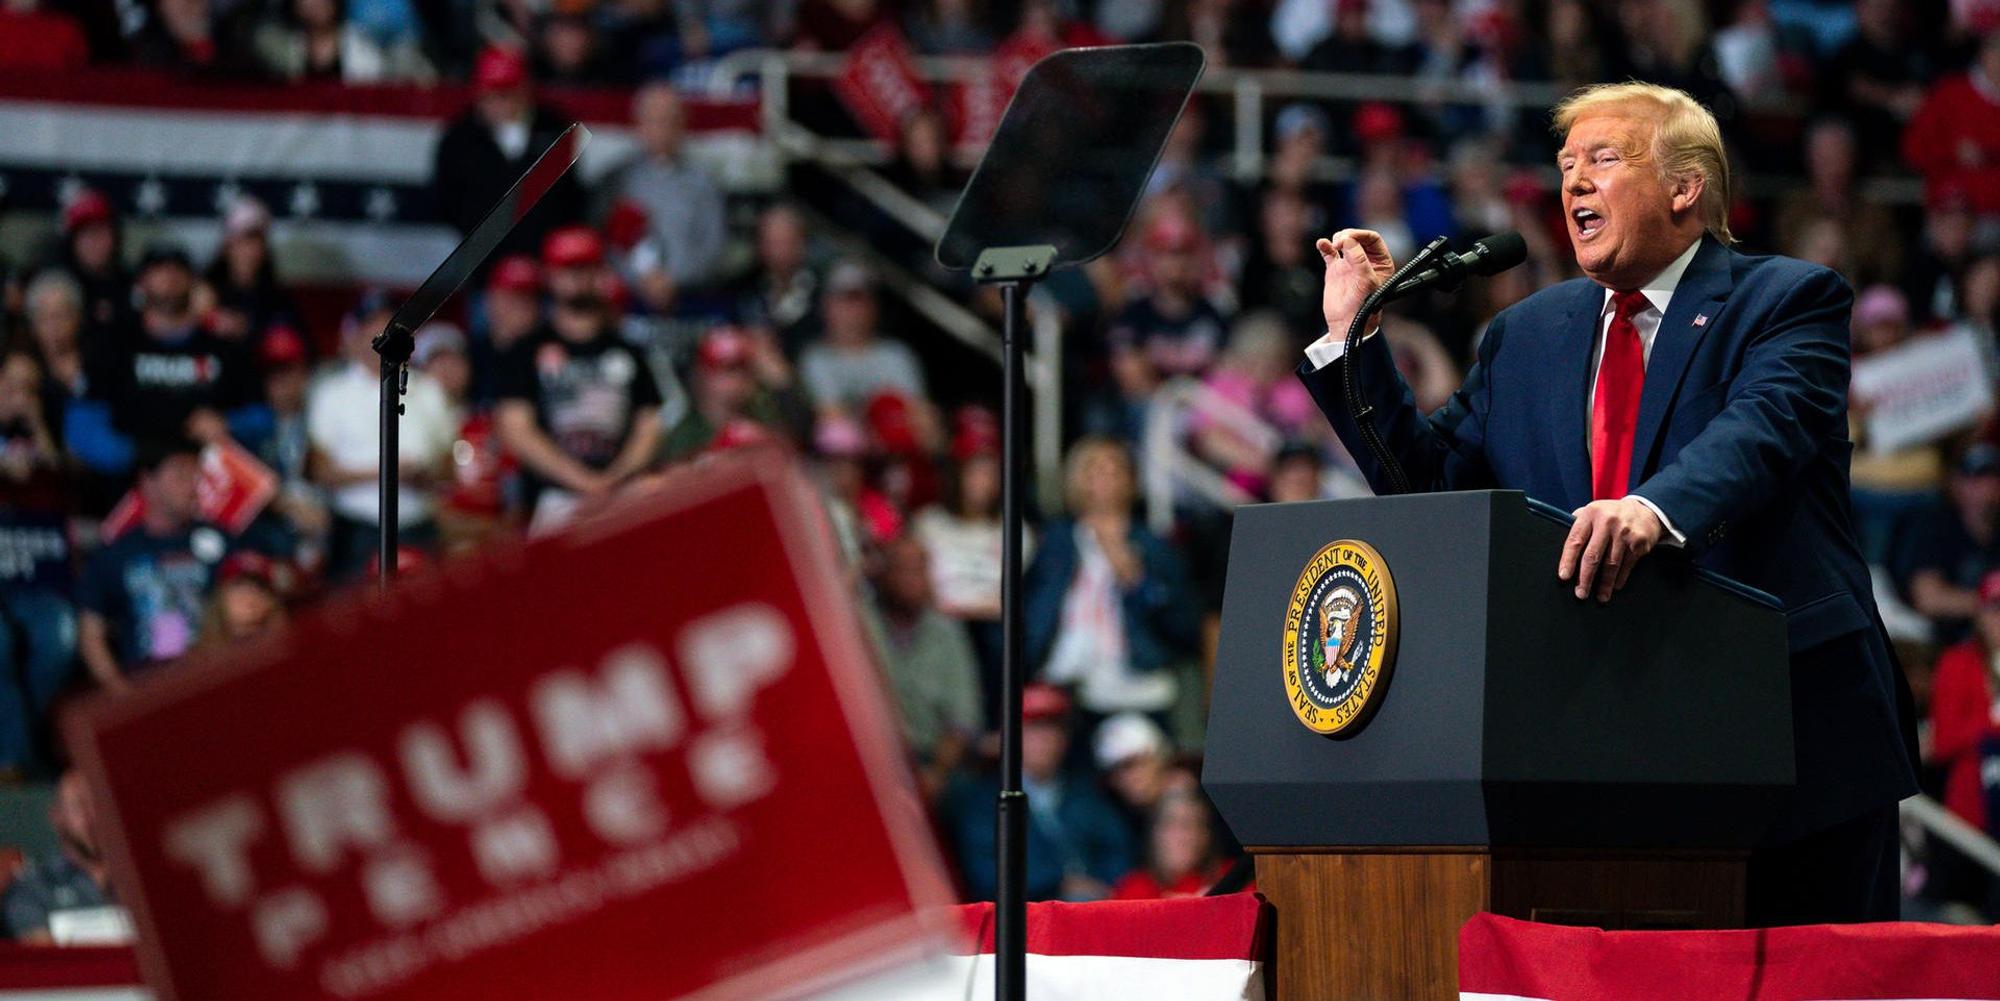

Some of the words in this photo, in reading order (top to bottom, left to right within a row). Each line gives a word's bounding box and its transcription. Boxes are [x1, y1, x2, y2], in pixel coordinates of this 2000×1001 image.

[1342, 549, 1353, 561] OF
[1354, 551, 1368, 570] THE
[1288, 548, 1341, 633] PRESIDENT
[1368, 570, 1385, 648] UNITED
[1288, 670, 1297, 686] OF
[1337, 665, 1376, 724] STATES
[1294, 684, 1318, 724] SEAL
[161, 604, 796, 908] TRUMP
